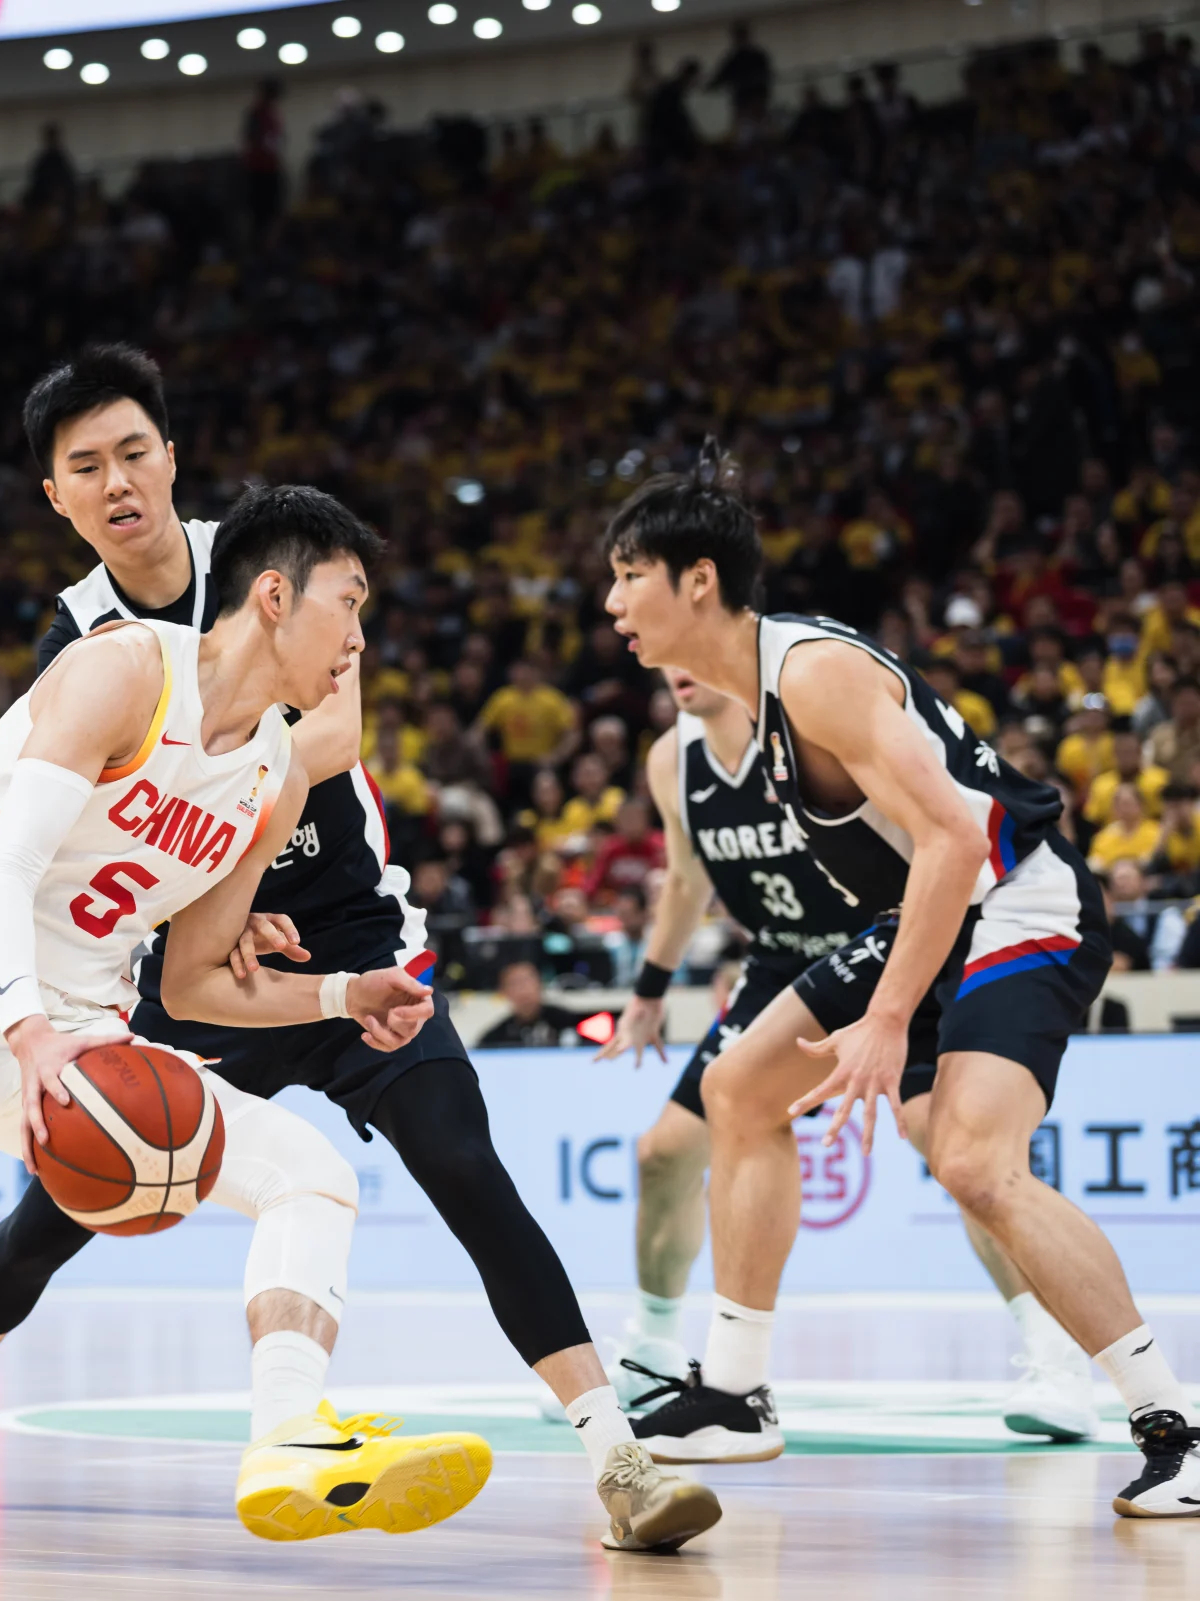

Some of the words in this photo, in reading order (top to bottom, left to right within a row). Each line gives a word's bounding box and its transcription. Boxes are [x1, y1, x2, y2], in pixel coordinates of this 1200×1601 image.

[108, 779, 237, 874] CHINA
[697, 820, 806, 862] KOREA
[69, 861, 161, 939] 5
[750, 870, 805, 921] 33
[559, 1138, 638, 1203] IC
